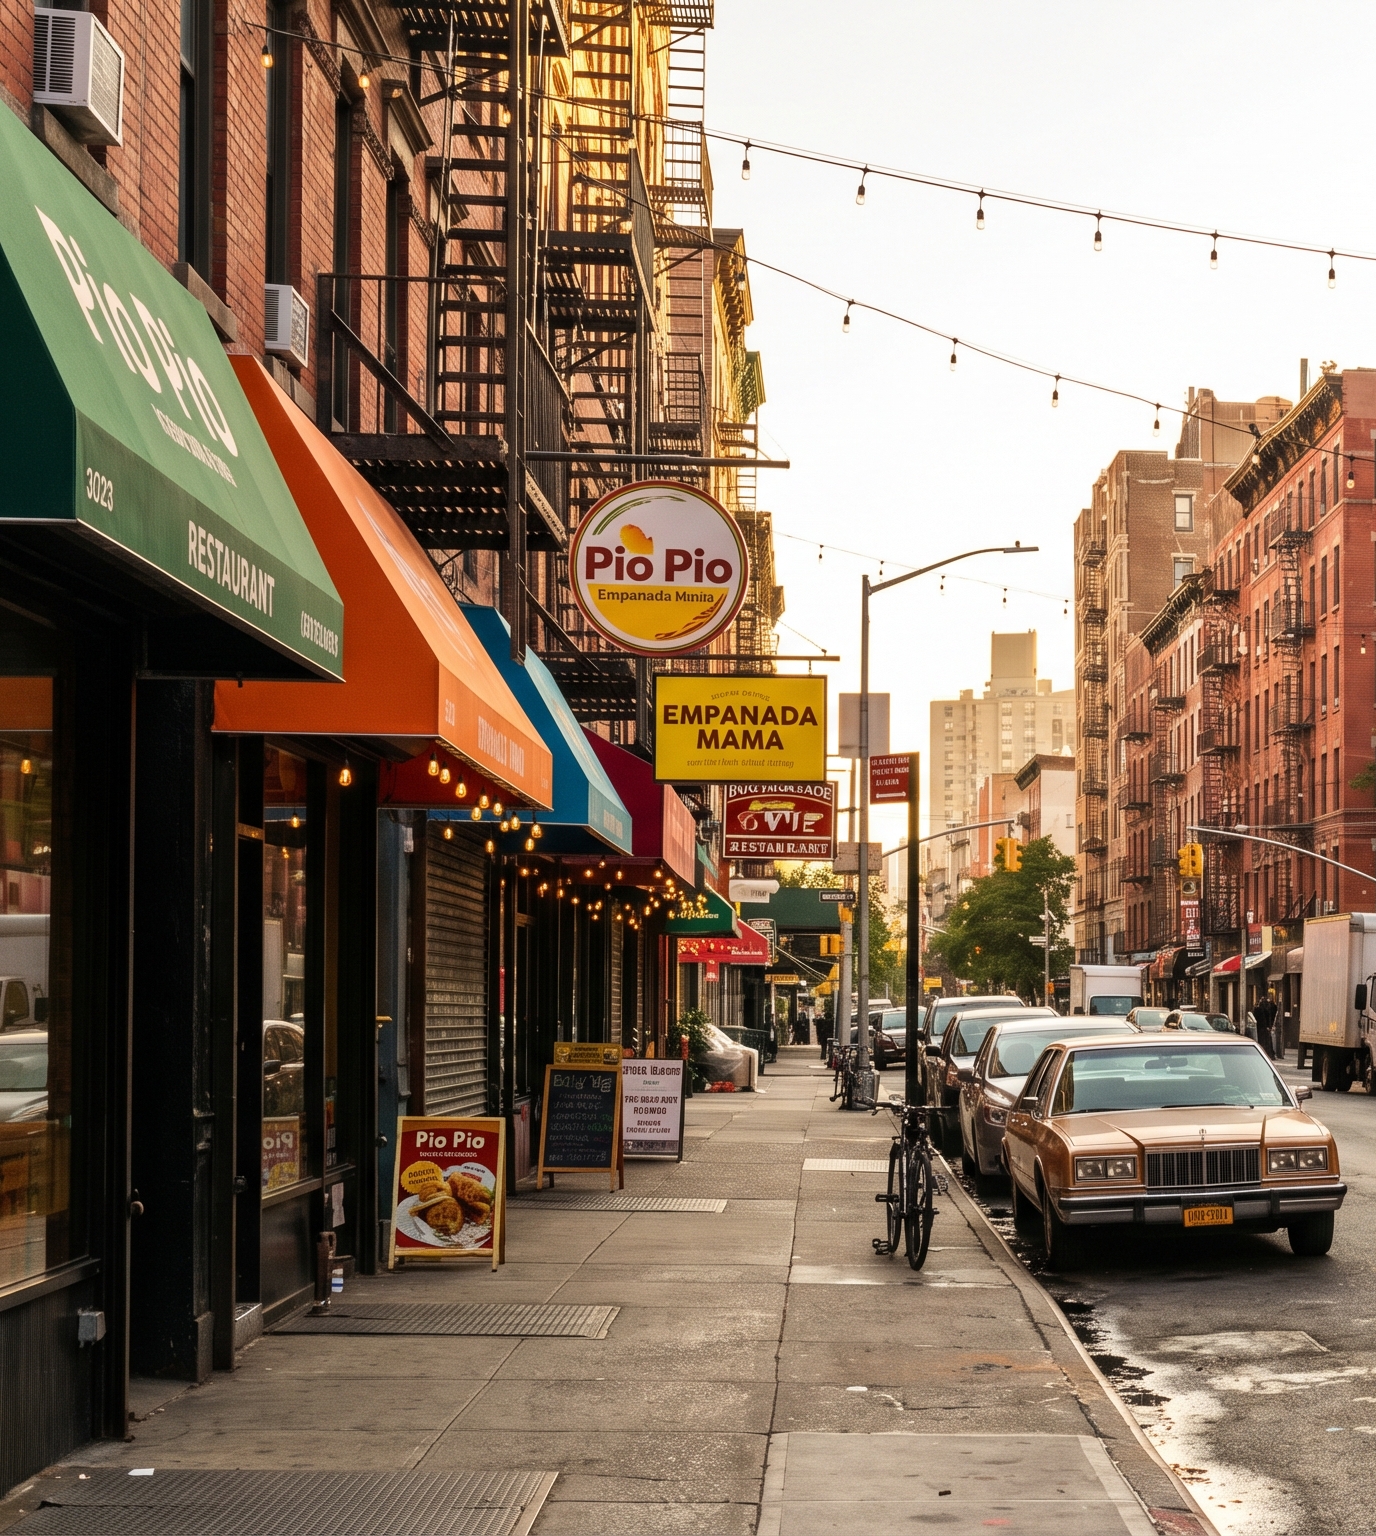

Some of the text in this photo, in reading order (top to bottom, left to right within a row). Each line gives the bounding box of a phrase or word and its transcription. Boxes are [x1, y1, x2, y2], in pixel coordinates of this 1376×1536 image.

[35, 204, 162, 394] Pio
[129, 292, 239, 458] Pio
[86, 467, 114, 512] 3023
[188, 519, 275, 618] RESTAURANT
[585, 545, 733, 584] Pio Pio
[598, 589, 672, 603] Empanada
[663, 705, 818, 726] EMPANADA
[696, 729, 784, 750] MAMA
[416, 1131, 447, 1149] Pio
